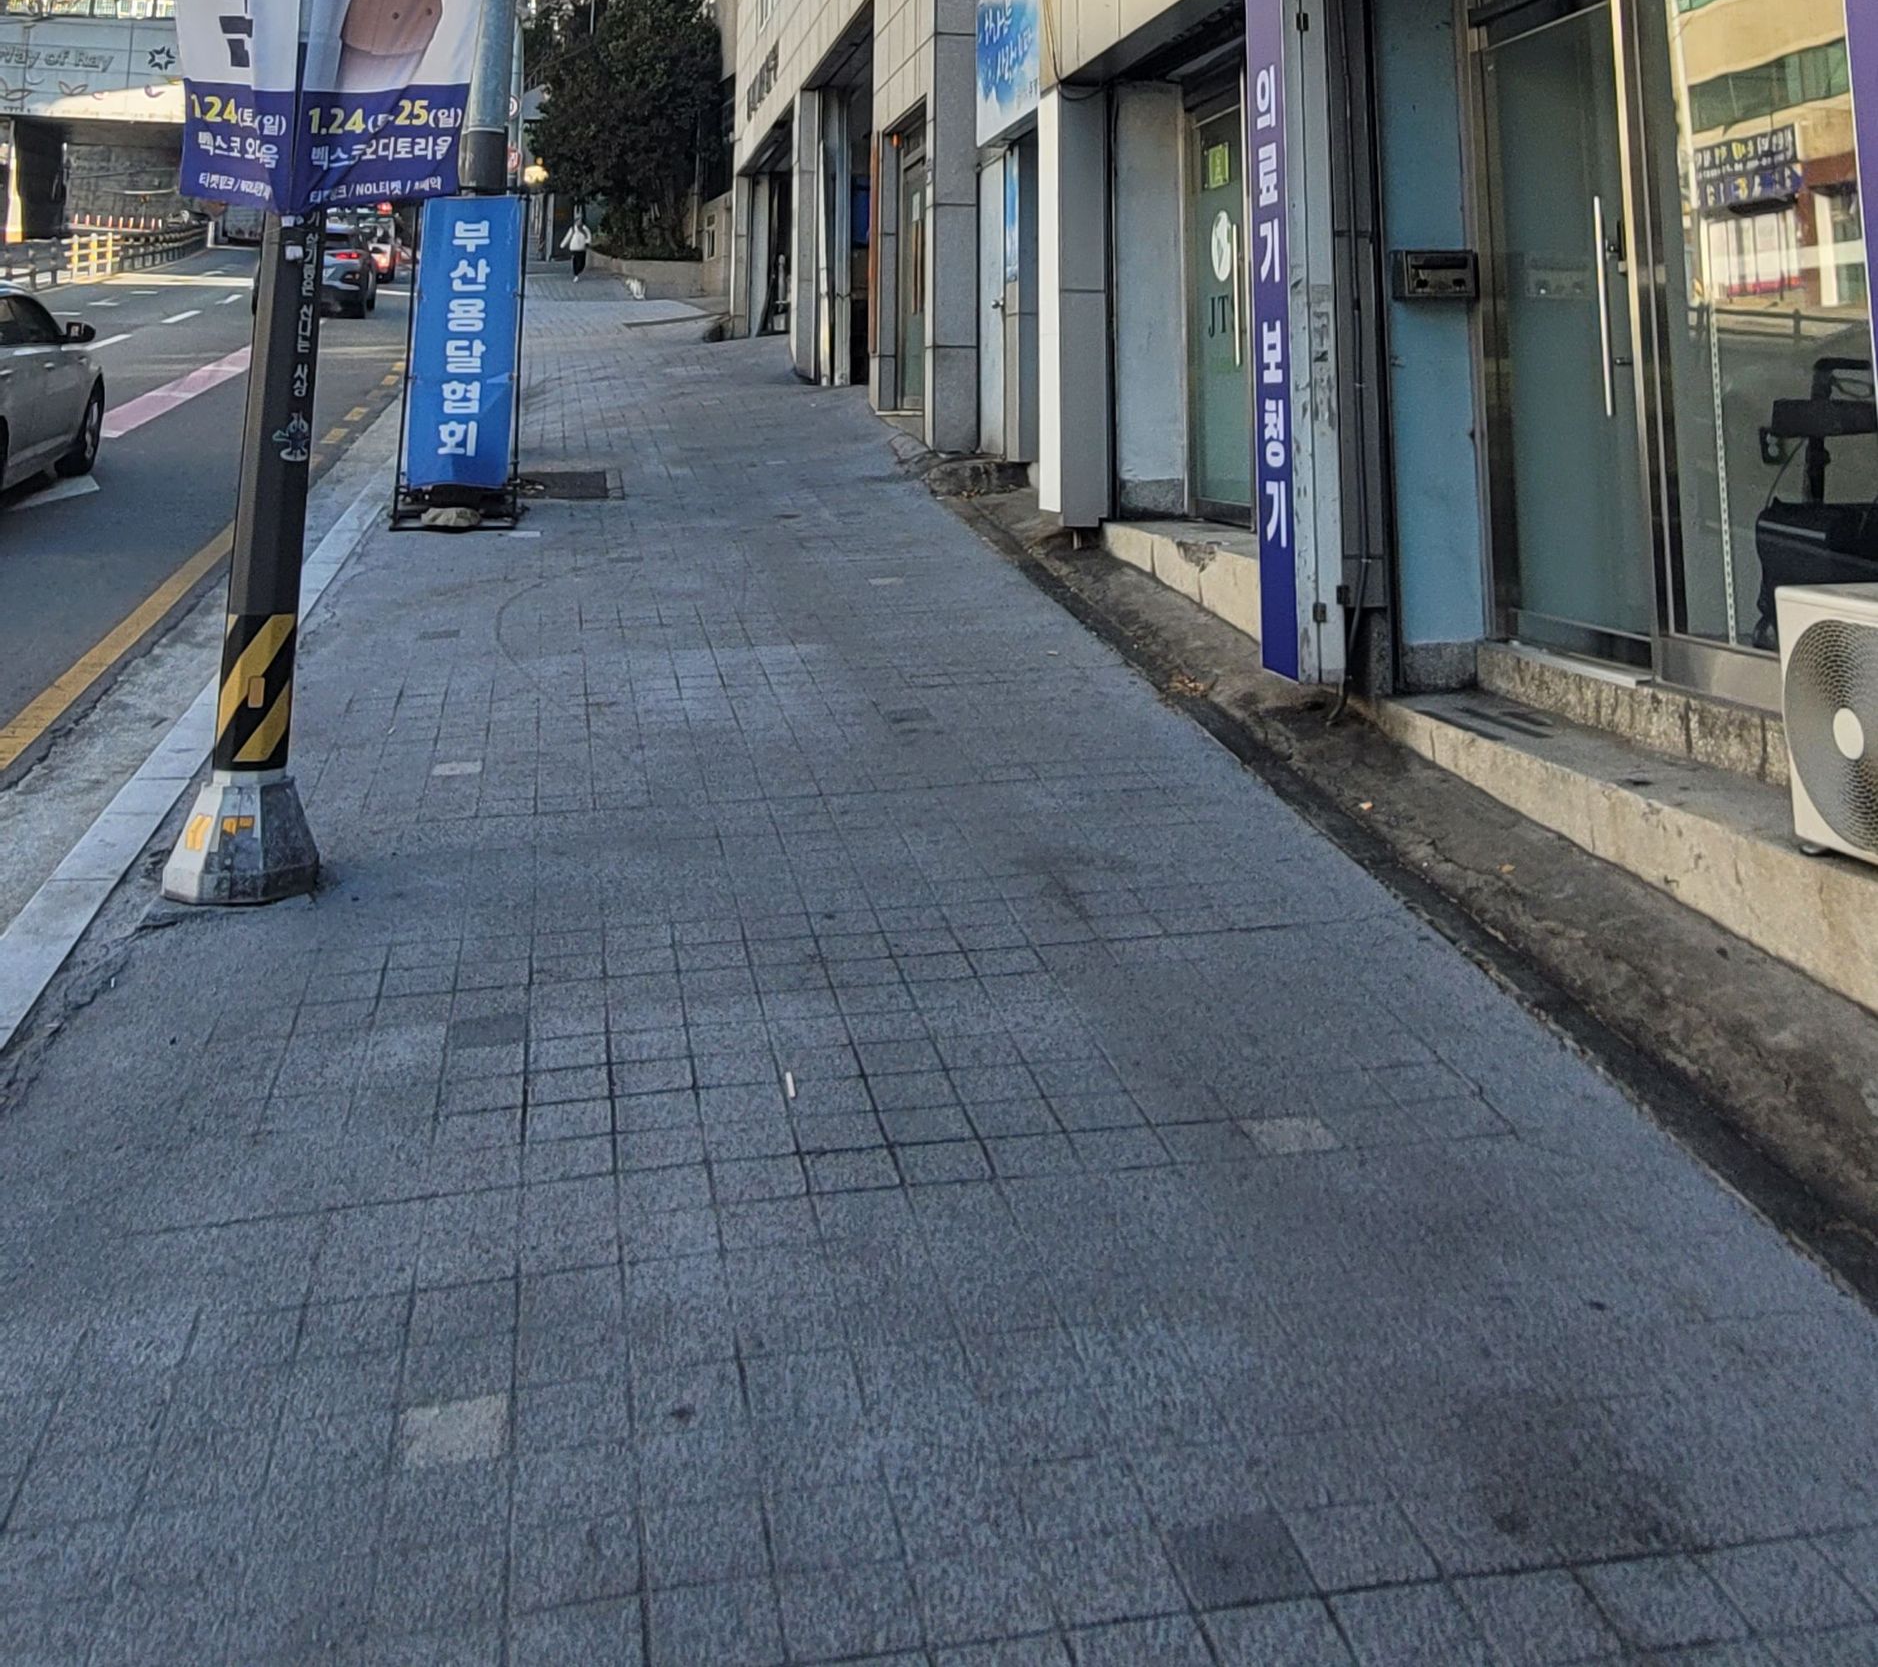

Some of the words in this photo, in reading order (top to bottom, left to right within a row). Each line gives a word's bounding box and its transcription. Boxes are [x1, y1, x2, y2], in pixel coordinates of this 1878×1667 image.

[1256, 63, 1281, 284] 의료기
[436, 220, 492, 457] 부산용달협회
[1261, 320, 1288, 549] 보청기
